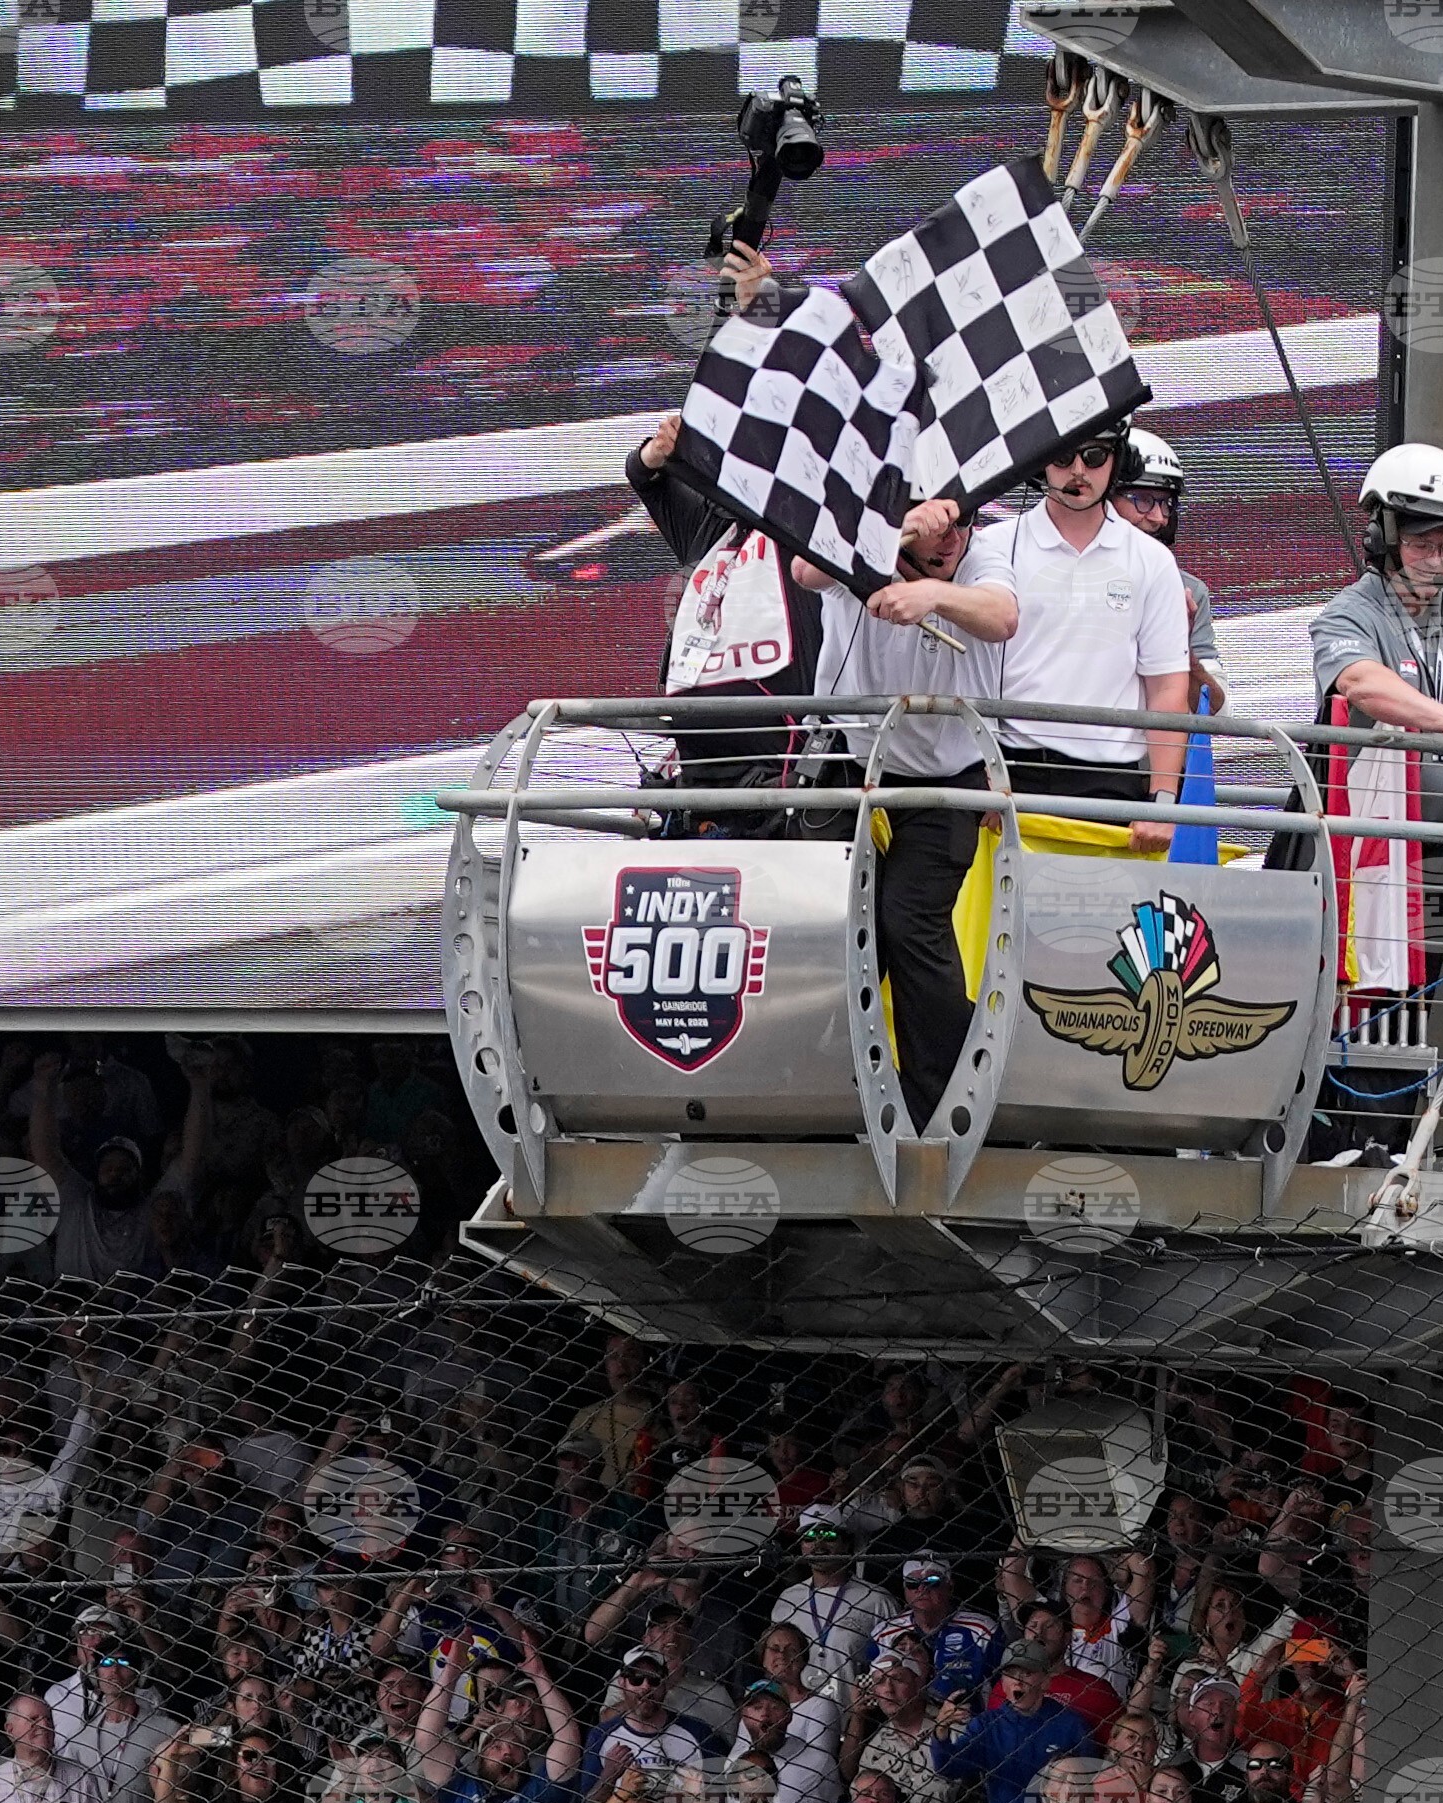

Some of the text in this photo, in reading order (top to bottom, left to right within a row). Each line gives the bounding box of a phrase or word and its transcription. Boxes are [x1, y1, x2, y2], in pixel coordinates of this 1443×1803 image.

[701, 639, 781, 674] OTO
[636, 891, 717, 923] INDY
[607, 927, 747, 995] 500
[655, 1018, 672, 1027] MAY
[661, 1001, 708, 1012] GAINBRIDGE
[1055, 985, 1253, 1074] INDIANAPOLIS MOTOR SPEEDWAY
